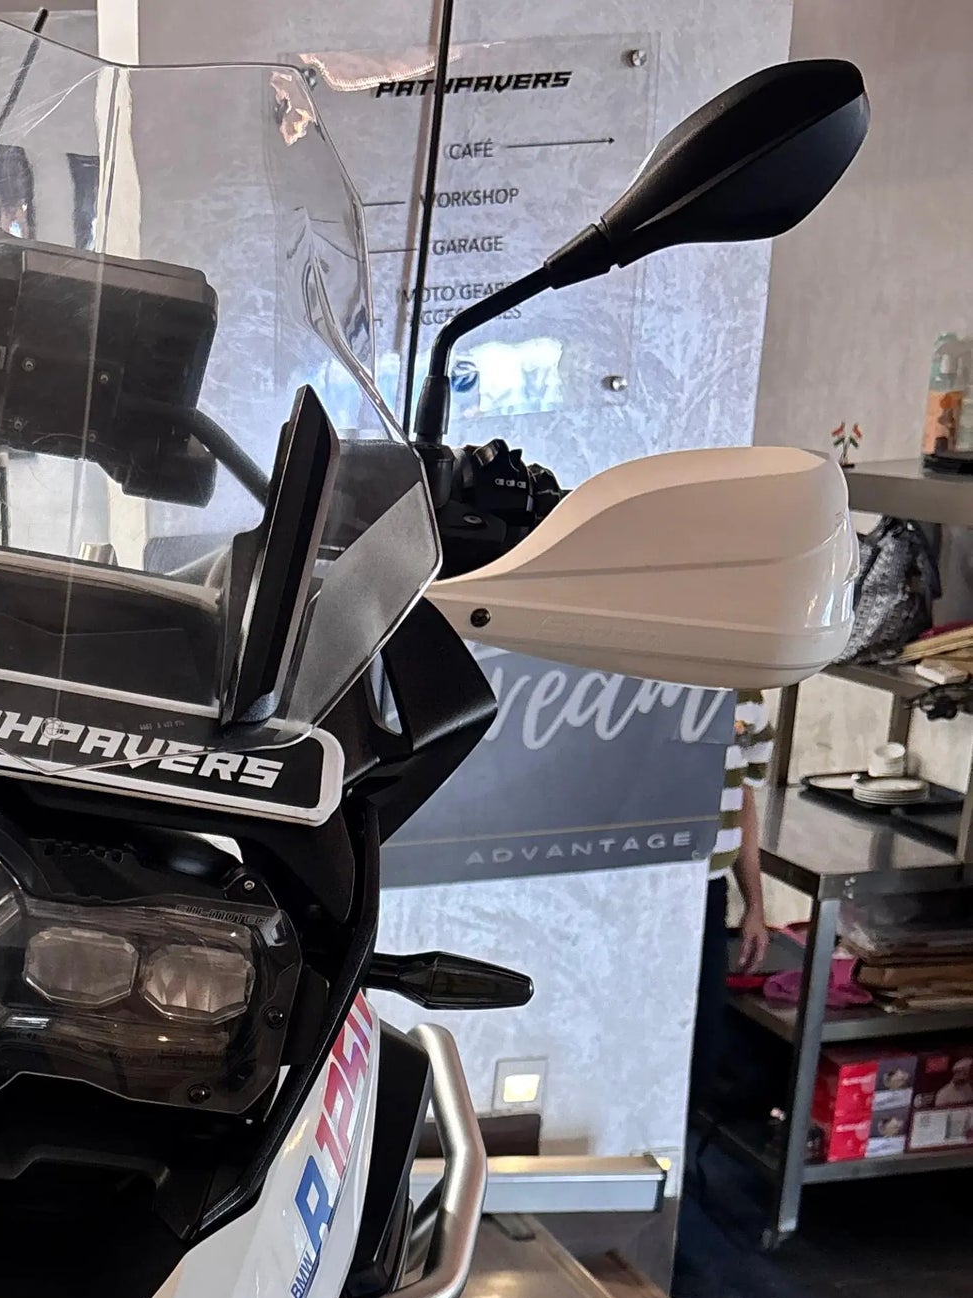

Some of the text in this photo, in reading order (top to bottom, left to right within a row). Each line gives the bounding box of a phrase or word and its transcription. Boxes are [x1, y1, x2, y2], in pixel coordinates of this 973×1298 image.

[449, 138, 493, 159] CAFÉ
[432, 236, 504, 256] GARAGE
[465, 831, 692, 865] ADVANTAGE
[295, 1155, 333, 1256] R
